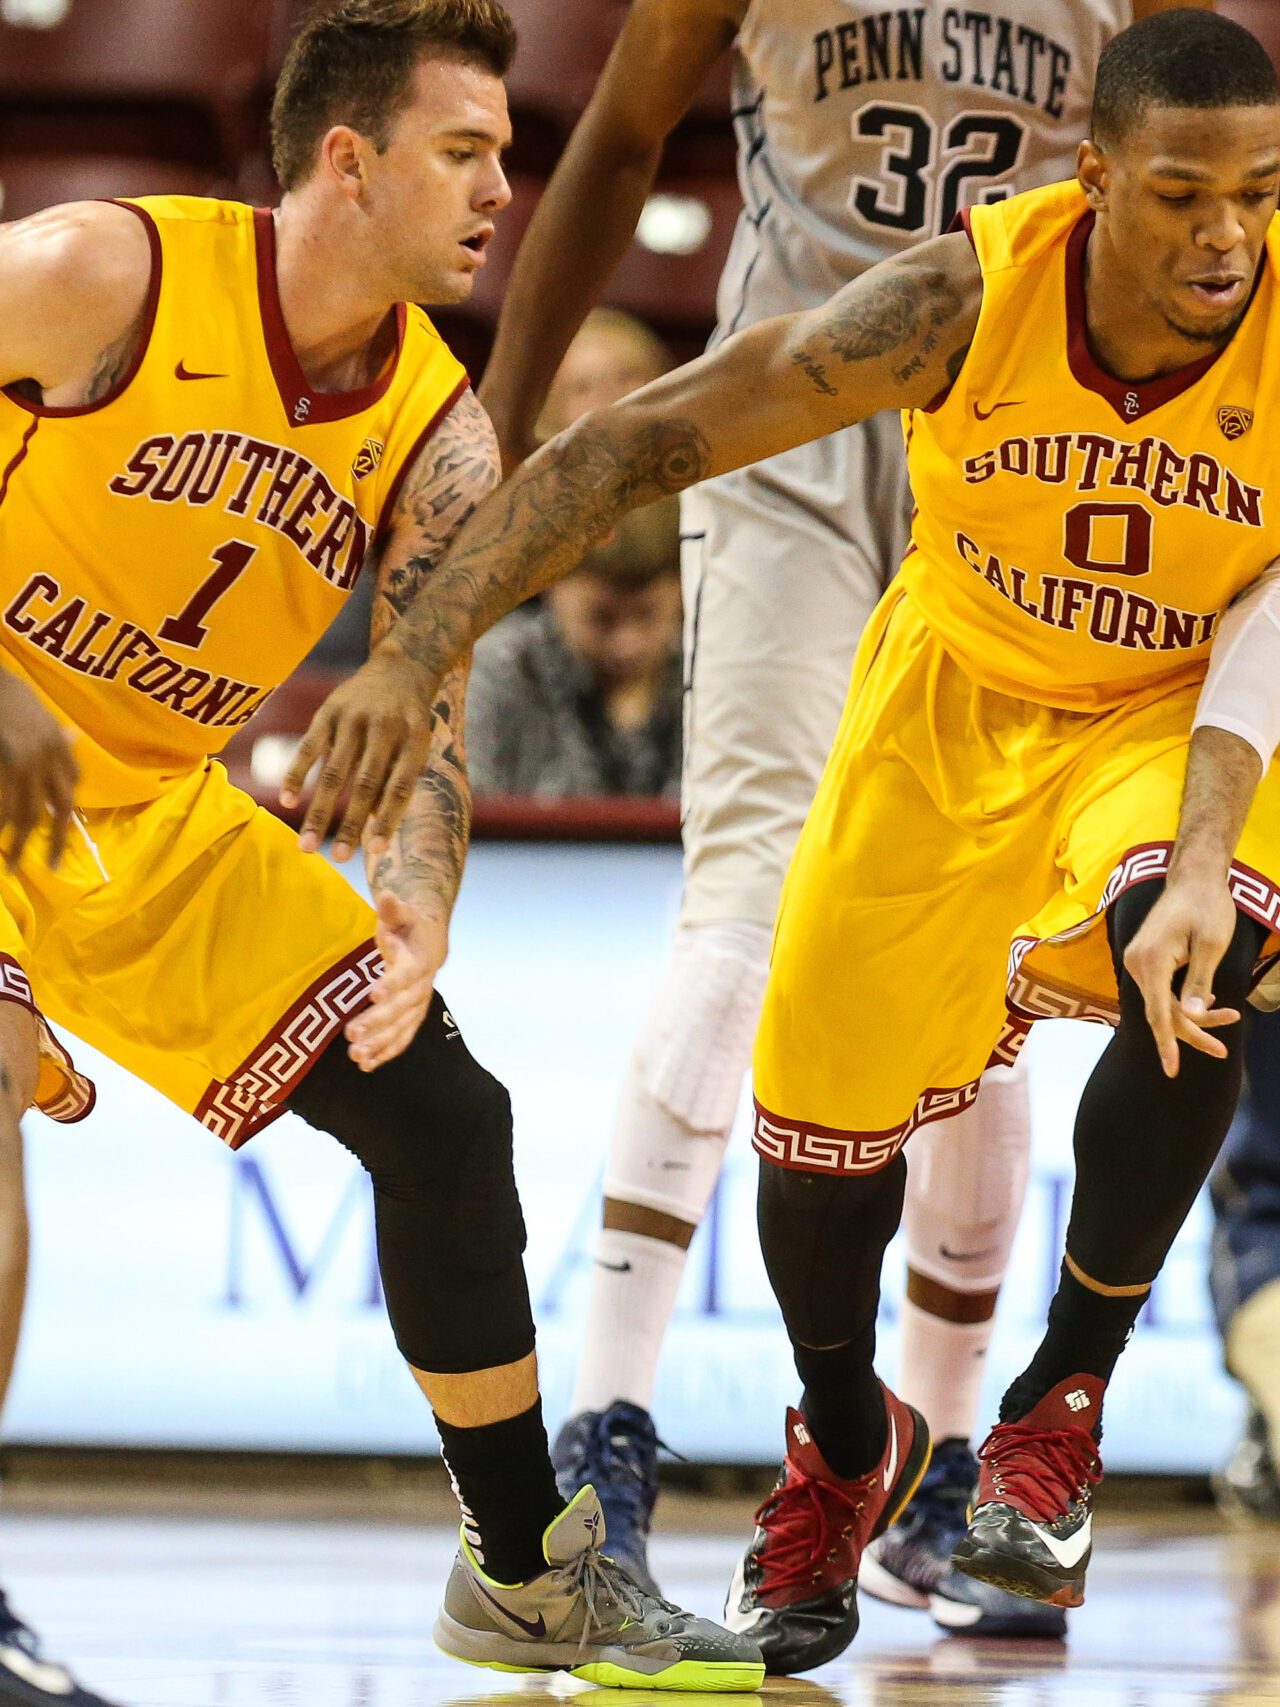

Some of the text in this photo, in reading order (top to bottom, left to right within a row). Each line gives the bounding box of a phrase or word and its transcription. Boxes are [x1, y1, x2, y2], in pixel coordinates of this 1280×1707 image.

[812, 8, 1072, 120] PENN STATE
[848, 99, 1031, 238] 32
[106, 430, 374, 592] SOUTHERN
[962, 431, 1264, 529] SOUTHERN
[155, 538, 260, 649] 1
[954, 531, 1220, 652] CALIFORNI
[1061, 501, 1155, 577] 0
